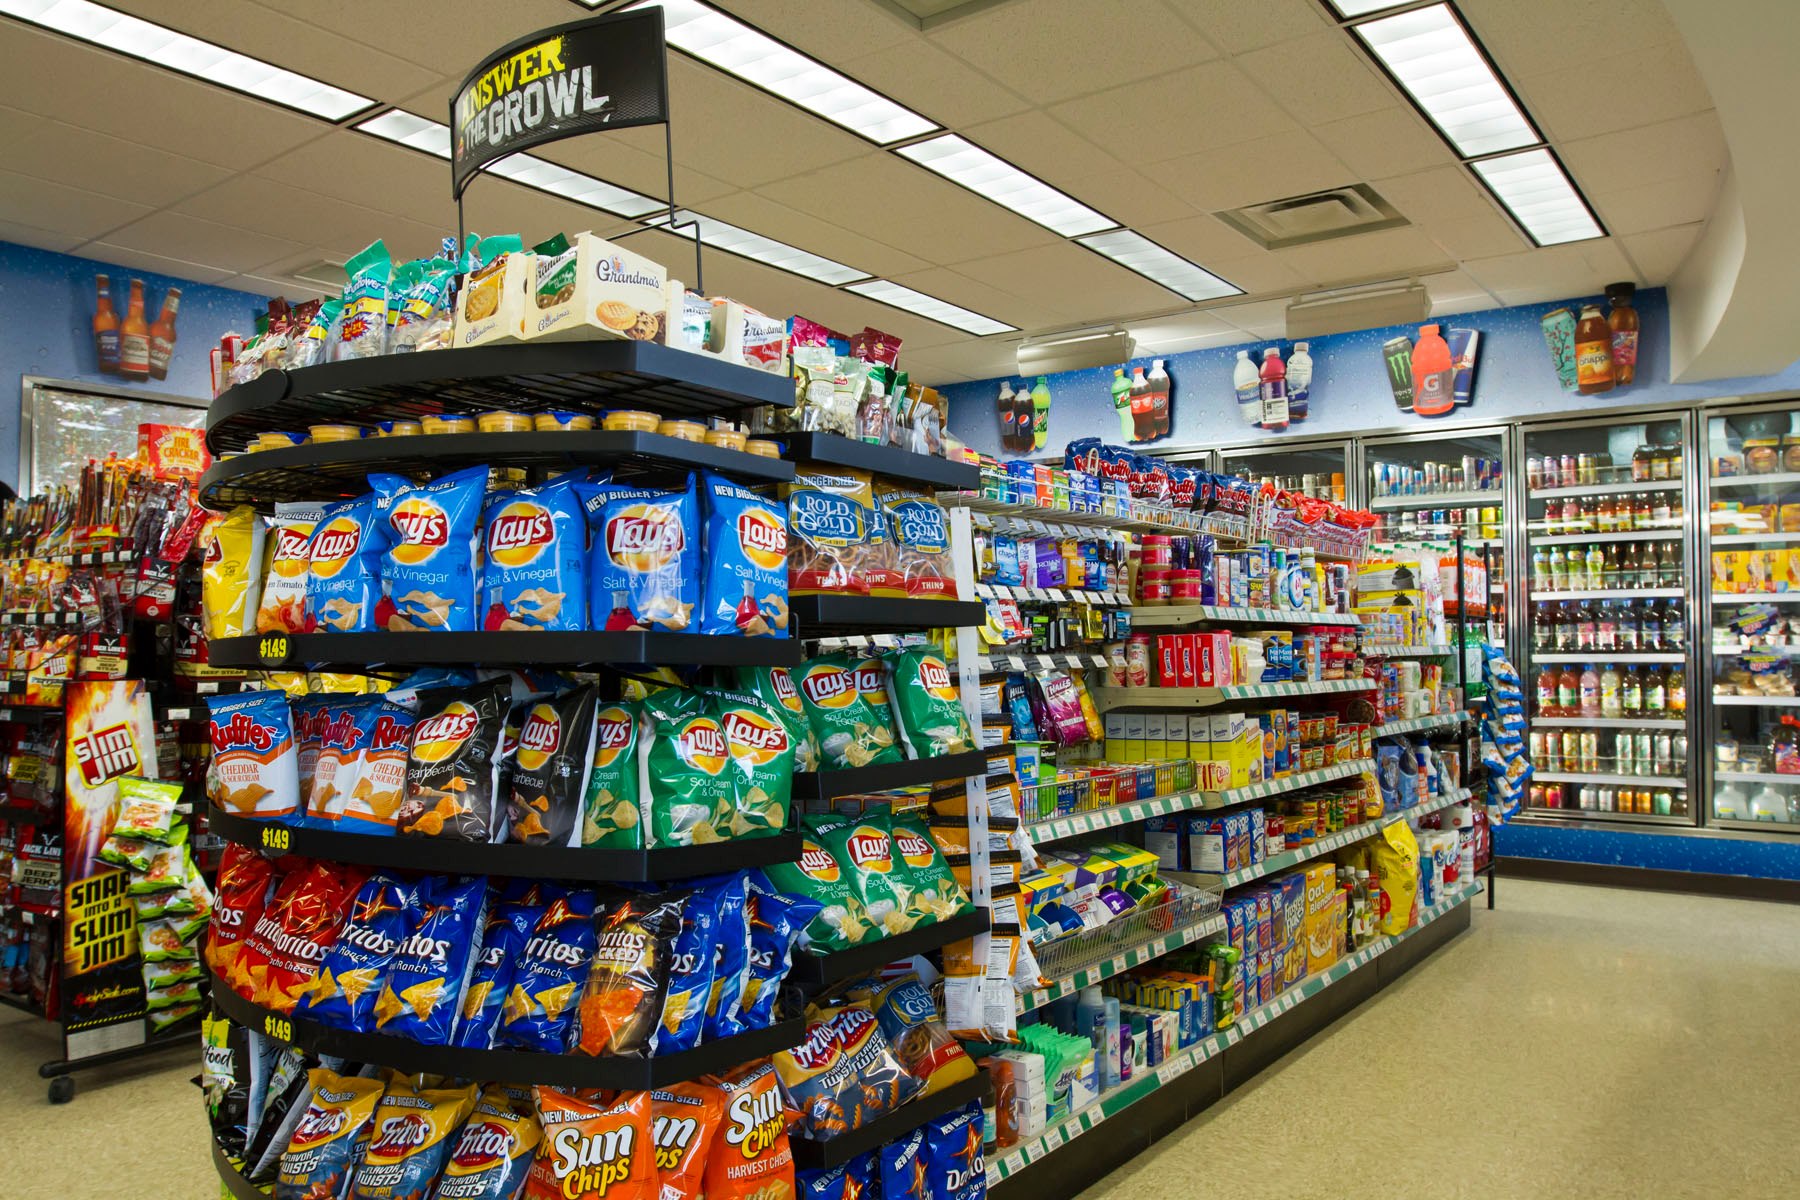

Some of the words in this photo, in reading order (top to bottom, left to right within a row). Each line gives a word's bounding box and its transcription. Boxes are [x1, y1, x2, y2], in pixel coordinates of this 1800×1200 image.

[461, 33, 566, 130] ANSWER
[464, 109, 487, 150] THE
[488, 65, 609, 146] GROWL
[597, 256, 660, 288] Grandma's
[538, 308, 570, 332] Grandma's
[465, 321, 496, 344] Grandma's
[1423, 374, 1440, 391] G
[174, 436, 190, 448] FIRE
[164, 446, 200, 459] CRACKER
[715, 485, 734, 497] NEW
[883, 491, 900, 503] NEW
[586, 493, 607, 513] NEW
[609, 490, 651, 501] BIGGER
[806, 496, 850, 516] ROLD
[286, 511, 322, 522] BIGGER
[801, 512, 856, 535] GOLD
[908, 508, 941, 524] ROLD
[490, 513, 548, 552] Lay's
[612, 517, 683, 554] Lay's
[743, 516, 787, 553] Lay's
[905, 522, 946, 542] GOLD
[311, 525, 360, 563] Lay's
[392, 569, 400, 579] &
[401, 570, 449, 586] Vinegar
[503, 572, 511, 583] &
[511, 567, 559, 584] Vinegar
[735, 564, 754, 579] Salt
[755, 569, 762, 580] &
[866, 573, 886, 584] HINS
[277, 579, 303, 590] Tomato
[322, 578, 357, 595] Vinegar
[603, 576, 626, 589] Salt
[628, 576, 638, 588] &
[639, 575, 688, 592] Vinegar
[921, 580, 945, 590] THINS
[260, 637, 288, 659] $1.49
[807, 671, 854, 701] Lay's
[219, 701, 247, 714] BIGGER
[247, 698, 267, 709] SIZE!
[724, 692, 759, 707] BIGGER
[210, 712, 277, 754] Ruffles
[413, 711, 478, 747] Lay's
[520, 715, 561, 751] Lay's
[724, 712, 787, 749] Lay's
[687, 727, 727, 758] Lay's
[221, 764, 259, 776] CHEDDAR
[226, 773, 242, 783] SOUR
[242, 773, 260, 783] CREAM
[376, 769, 393, 782] SOUR
[407, 762, 455, 781] Barbecue
[593, 769, 619, 781] Cream
[513, 773, 544, 790] arbecue
[690, 776, 712, 788] Sour
[712, 778, 732, 790] Cream
[701, 787, 708, 798] &
[816, 822, 836, 836] NEW
[262, 827, 289, 850] $1.49
[898, 834, 929, 857] ay's
[852, 832, 891, 864] Lay's
[799, 850, 833, 872] Lay's
[21, 877, 60, 886] JERKY
[24, 869, 57, 878] BEEF
[867, 875, 886, 888] Sour
[912, 869, 923, 880] our
[924, 866, 946, 878] Cream
[919, 876, 925, 885] &
[925, 872, 944, 884] Onion
[71, 872, 131, 910] SNAP
[1308, 880, 1324, 901] Oat
[84, 903, 110, 918] INTO
[114, 900, 121, 908] A
[1284, 894, 1306, 922] Frosted
[74, 908, 131, 947] SLIM
[81, 933, 125, 970] JIM
[339, 945, 367, 962] Ranch
[398, 961, 428, 974] Ranch
[530, 962, 562, 978] Ranch
[906, 996, 932, 1016] GOL
[1182, 998, 1192, 1033] TAMPAX
[265, 1016, 291, 1042] $1.49
[826, 1053, 848, 1077] FLAVOR
[381, 1095, 396, 1106] NEW
[397, 1096, 416, 1107] BIGGER
[677, 1094, 703, 1106] SIZE!
[500, 1111, 520, 1122] SIZE!
[544, 1111, 562, 1125] NEW
[726, 1084, 783, 1145] Sun
[370, 1114, 431, 1150] Fritos
[653, 1116, 697, 1148] un
[740, 1112, 784, 1159] Chips
[940, 1122, 953, 1136] NEW
[453, 1121, 515, 1158] Fritos
[285, 1151, 313, 1162] FLAVOR
[552, 1124, 634, 1179] Sun
[365, 1166, 400, 1176] FLAVOR
[727, 1161, 768, 1180] HARVEST
[895, 1155, 907, 1172] NEW
[357, 1167, 406, 1187] TWISTS
[447, 1173, 481, 1187] FLAVOR
[562, 1156, 631, 1200] Chips
[812, 1173, 828, 1192] NEW
[438, 1180, 488, 1197] TWISTS
